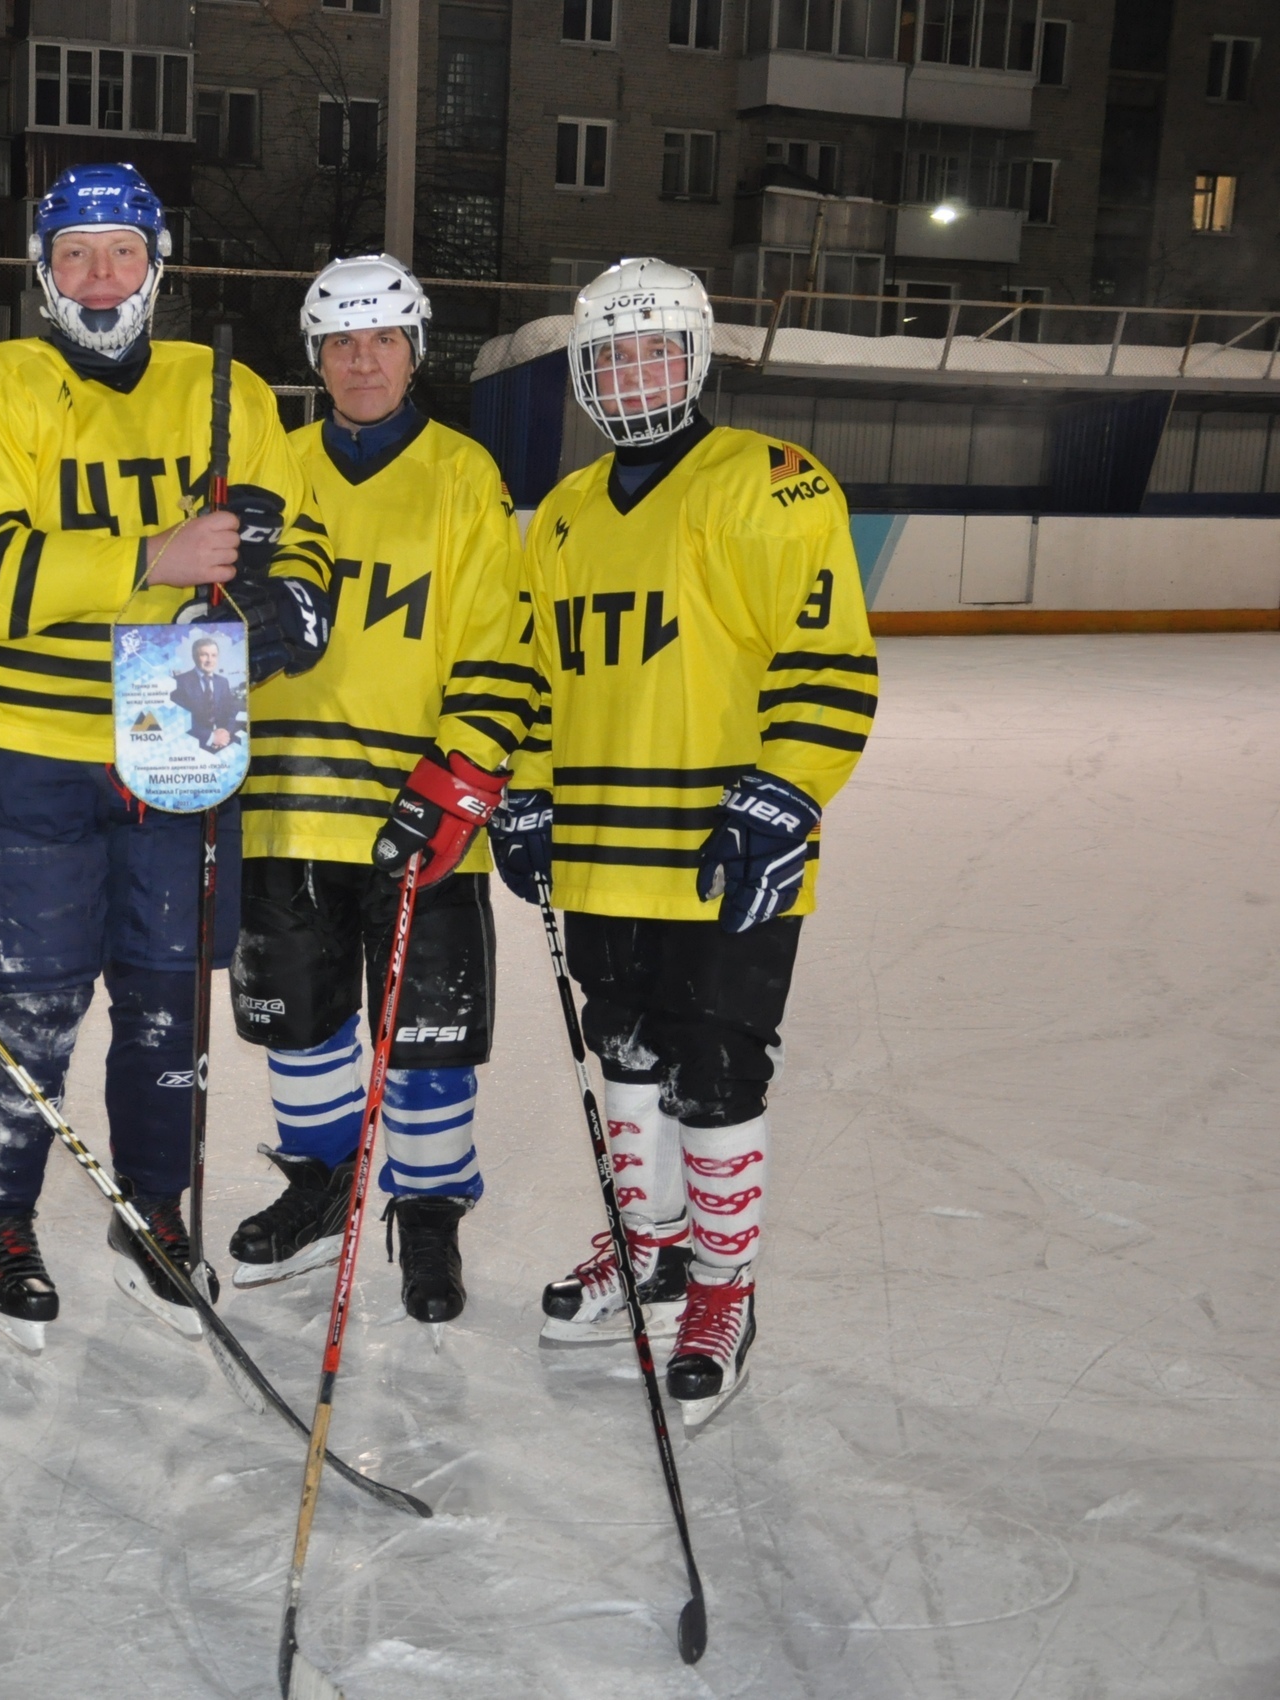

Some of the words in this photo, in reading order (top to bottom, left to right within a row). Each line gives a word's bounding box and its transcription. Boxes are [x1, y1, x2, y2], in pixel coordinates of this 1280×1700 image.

[77, 186, 122, 197] CCM
[338, 297, 378, 309] EFSI
[603, 293, 656, 311] JOFA
[770, 475, 831, 508] ТИЗО
[329, 558, 433, 641] ТИ
[283, 579, 319, 648] CM
[130, 733, 164, 742] ТИЗОЛ
[148, 773, 218, 785] МАНСУРОВА
[398, 798, 425, 819] NRG
[238, 993, 286, 1015] NRG
[248, 1012, 271, 1024] 115
[395, 1026, 468, 1043] EFSI
[589, 1108, 602, 1142] VAPOR
[337, 1207, 361, 1303] TITAN
